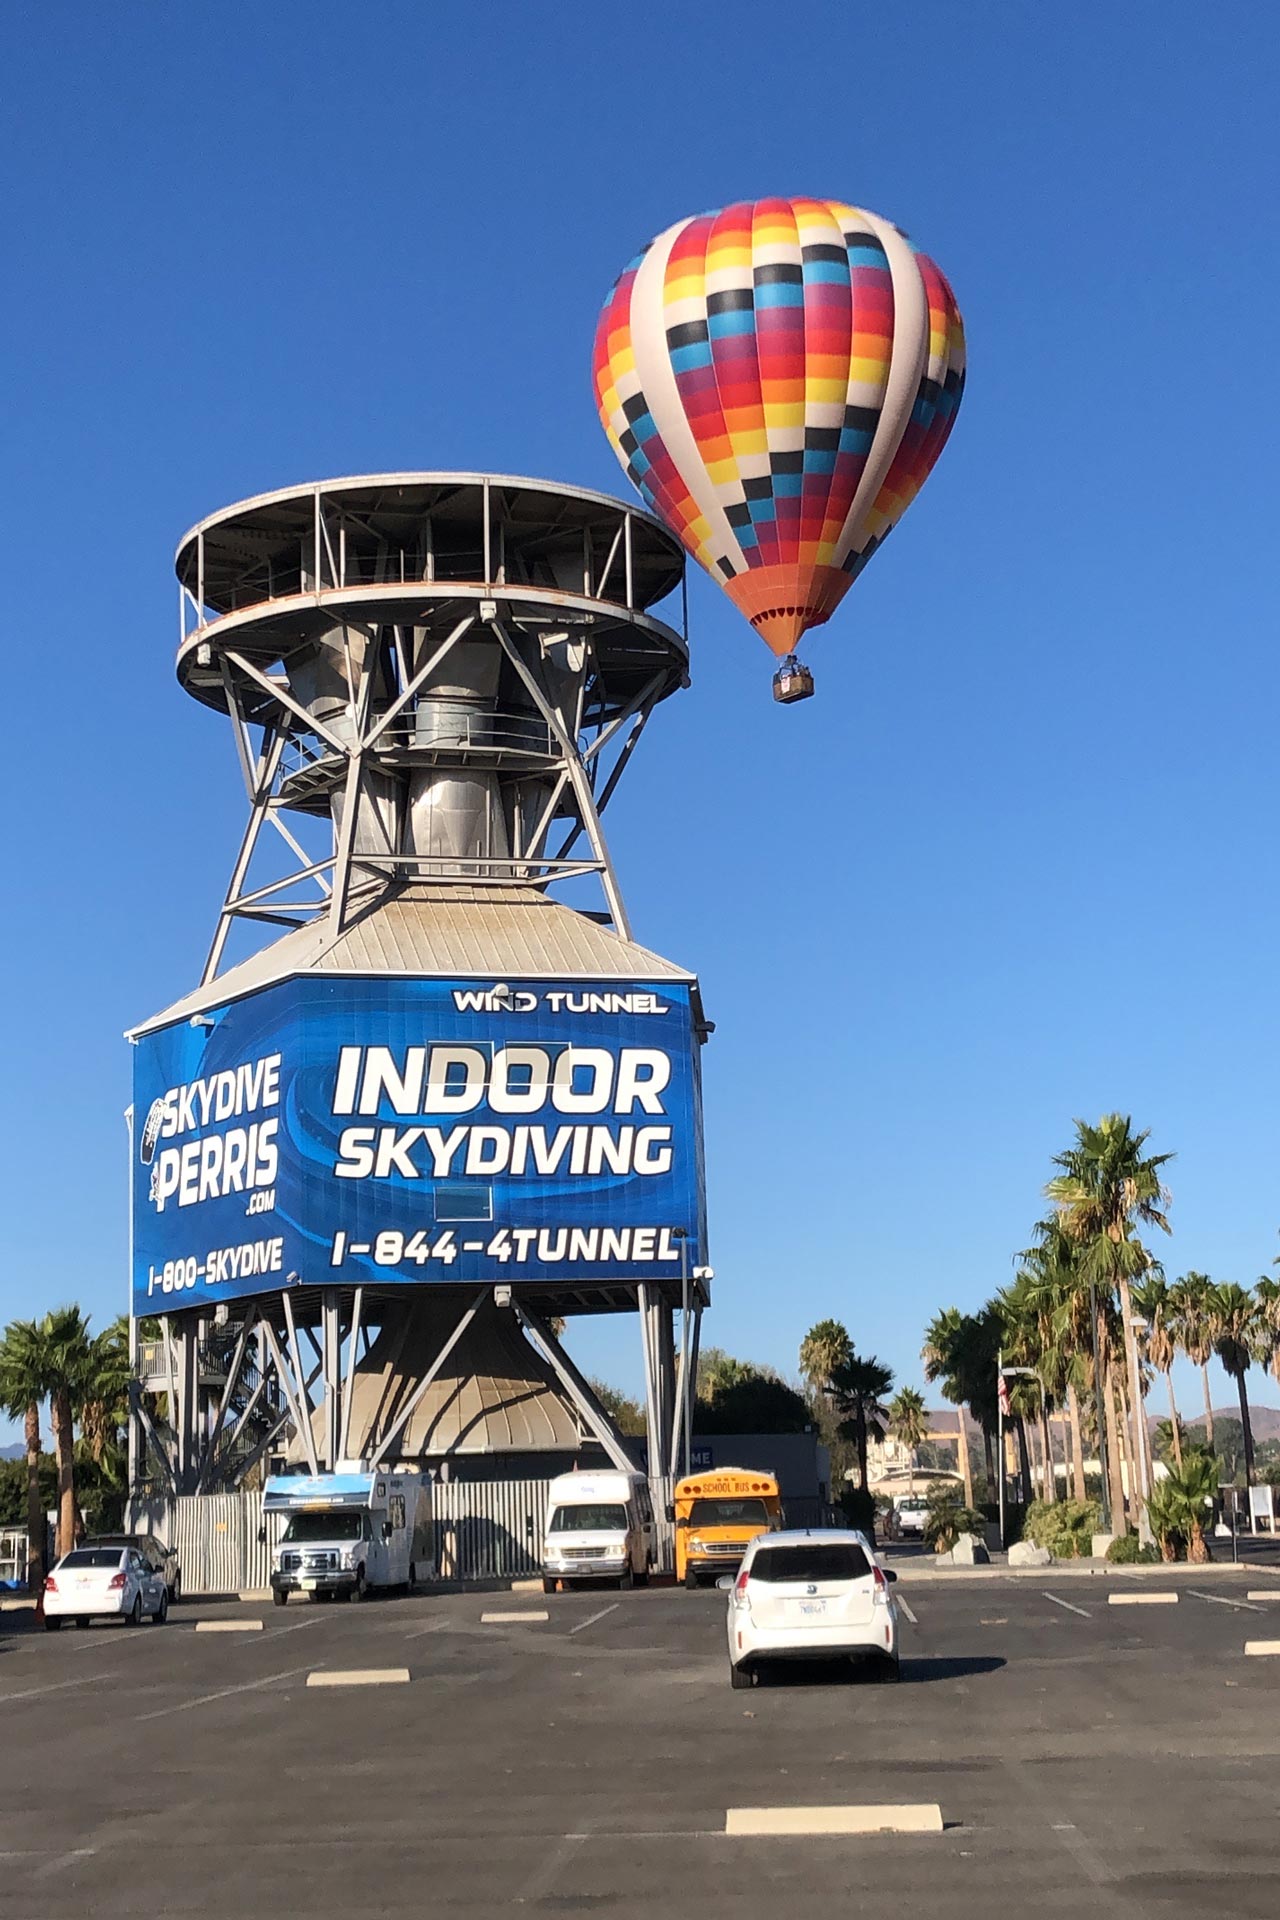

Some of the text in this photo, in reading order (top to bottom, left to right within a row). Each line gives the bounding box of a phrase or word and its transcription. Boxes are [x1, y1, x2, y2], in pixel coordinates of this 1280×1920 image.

[453, 991, 670, 1014] WIND TUNNEL
[161, 1053, 282, 1138] SKYDIVE
[332, 1046, 671, 1115] INDOOR
[156, 1118, 279, 1213] PERRIS
[334, 1126, 672, 1178] SKYDIVING
[245, 1189, 276, 1216] .COM
[147, 1237, 283, 1297] 1-800-SKYDIVE
[702, 1481, 750, 1493] SCHOOL BUS
